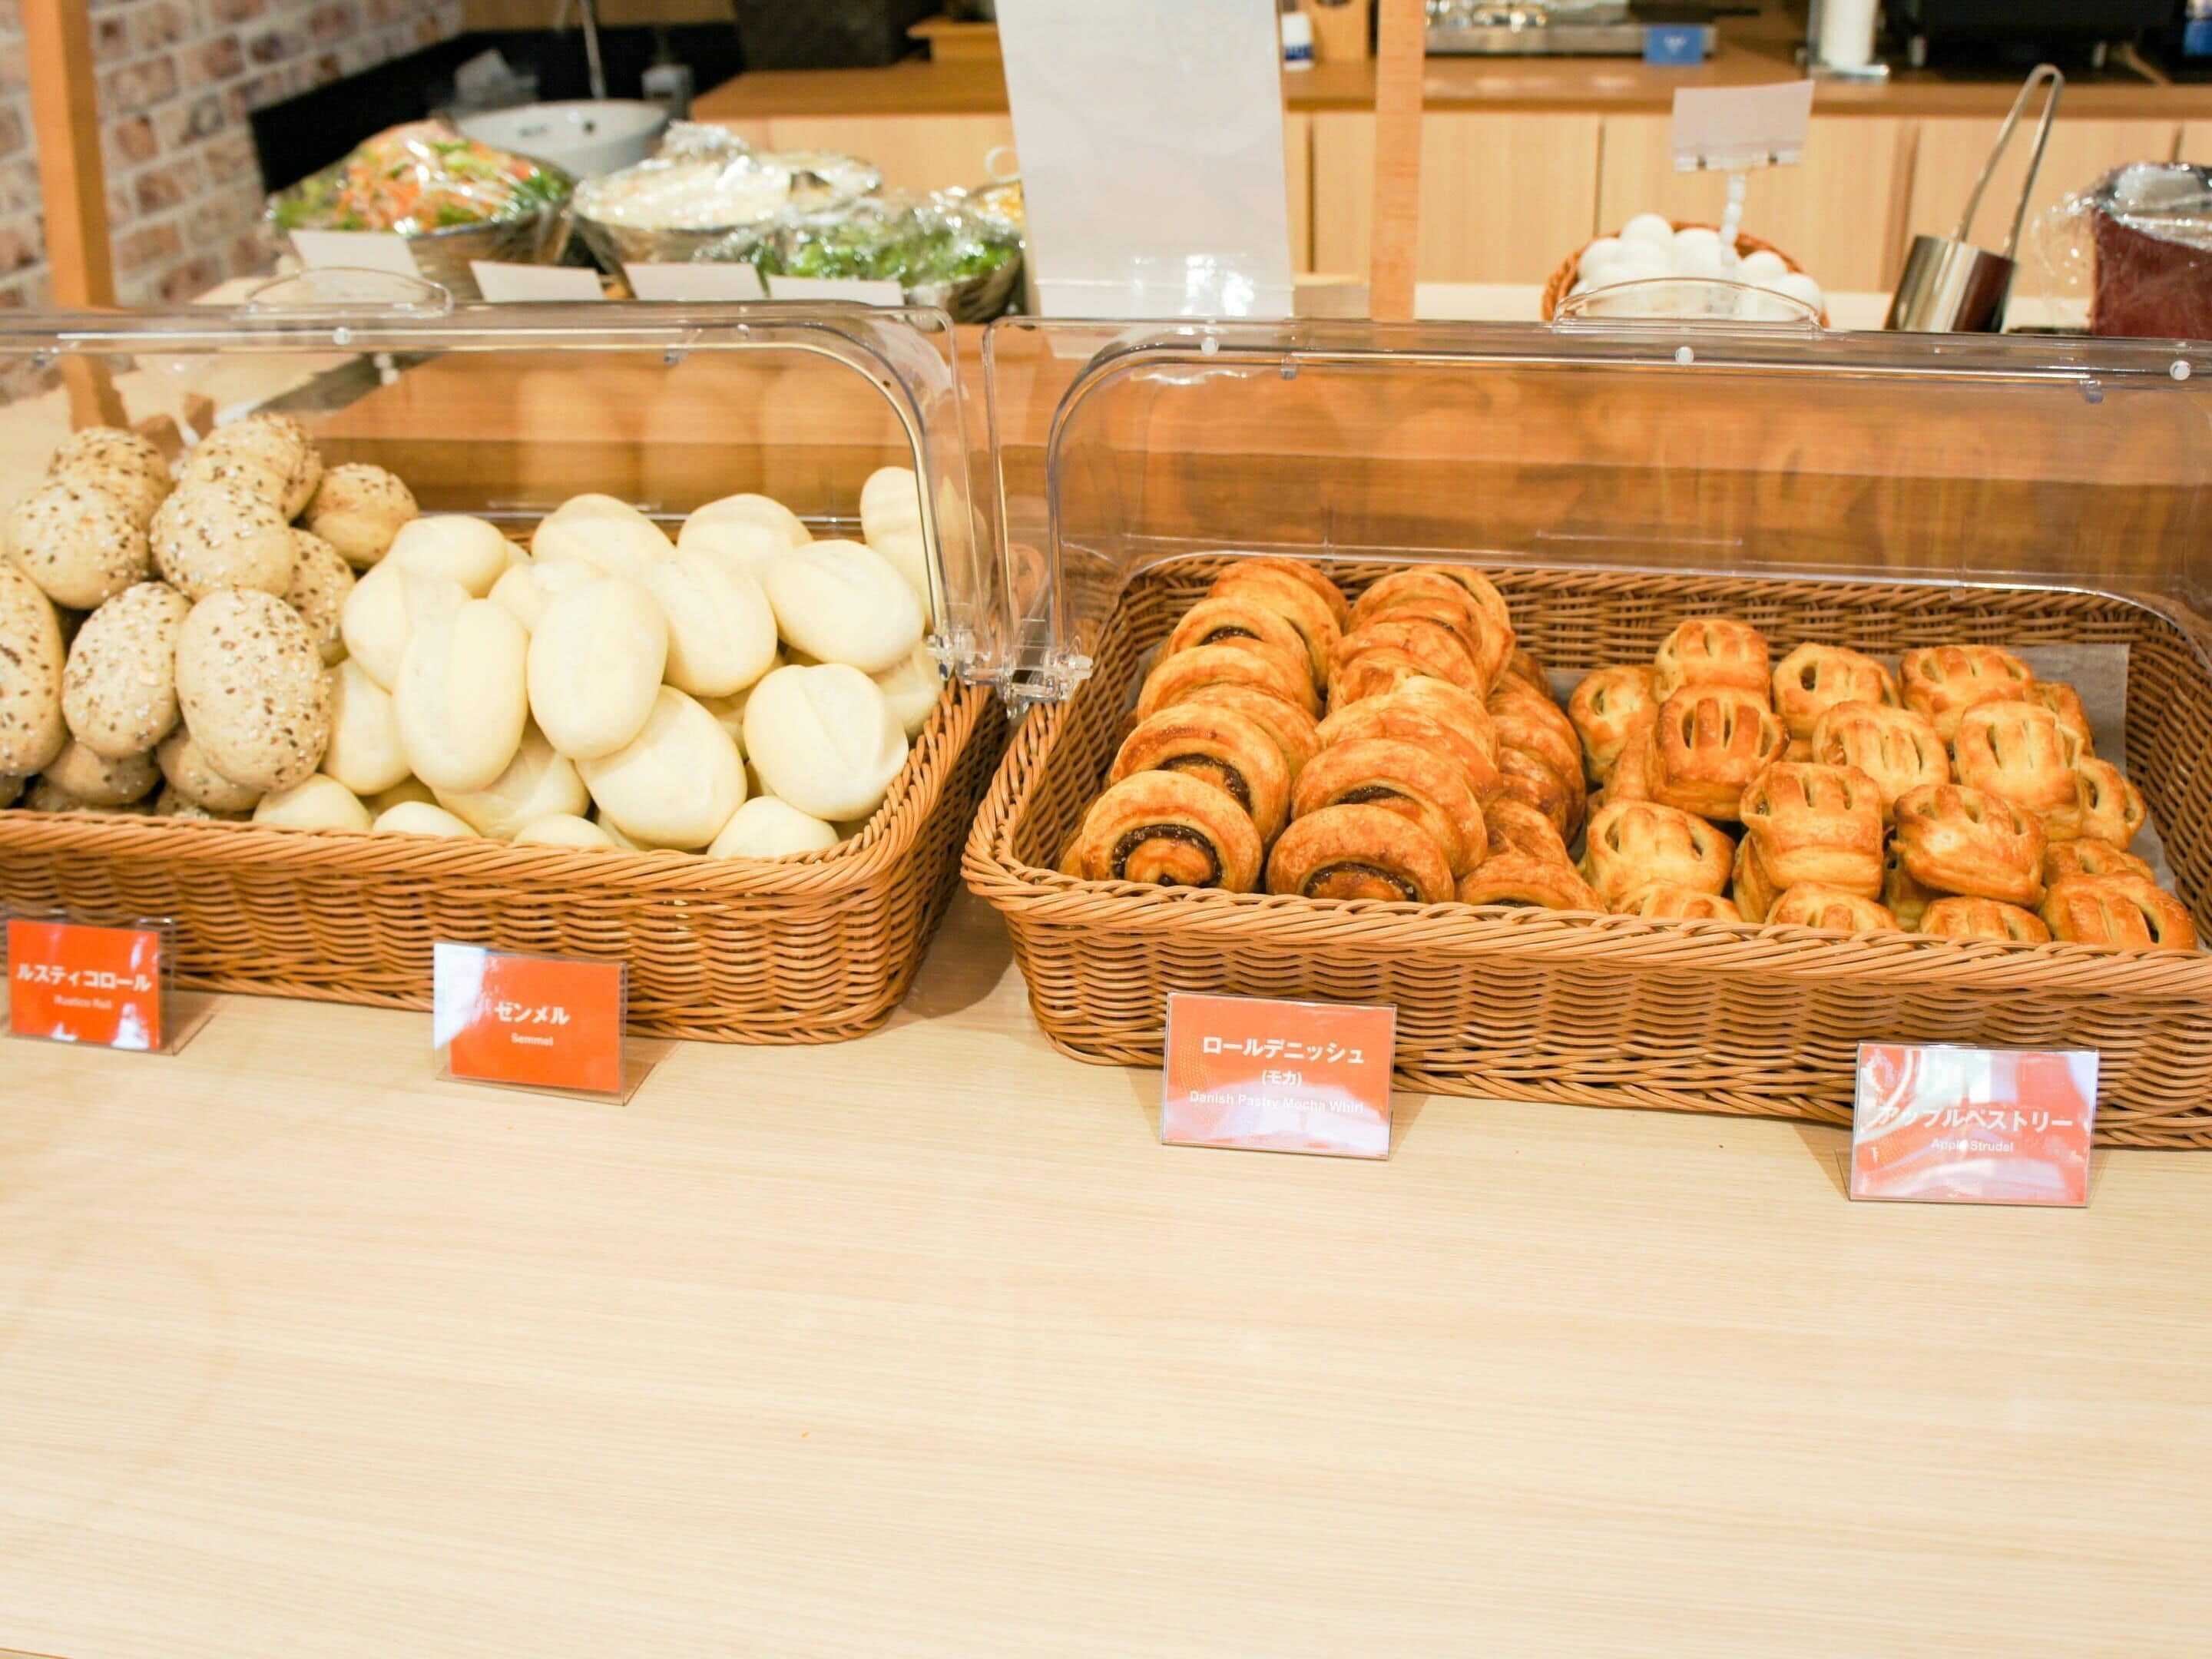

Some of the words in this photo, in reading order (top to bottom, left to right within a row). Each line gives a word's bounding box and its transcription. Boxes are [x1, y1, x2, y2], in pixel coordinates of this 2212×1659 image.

[17, 963, 152, 992] ルスティコロール
[495, 1002, 570, 1025] ゼンメル
[1203, 1037, 1364, 1064] ロールデニッシュ
[1262, 1069, 1302, 1087] (モカ)
[1190, 1091, 1233, 1104] Danish
[1970, 1138, 2014, 1152] Strudel
